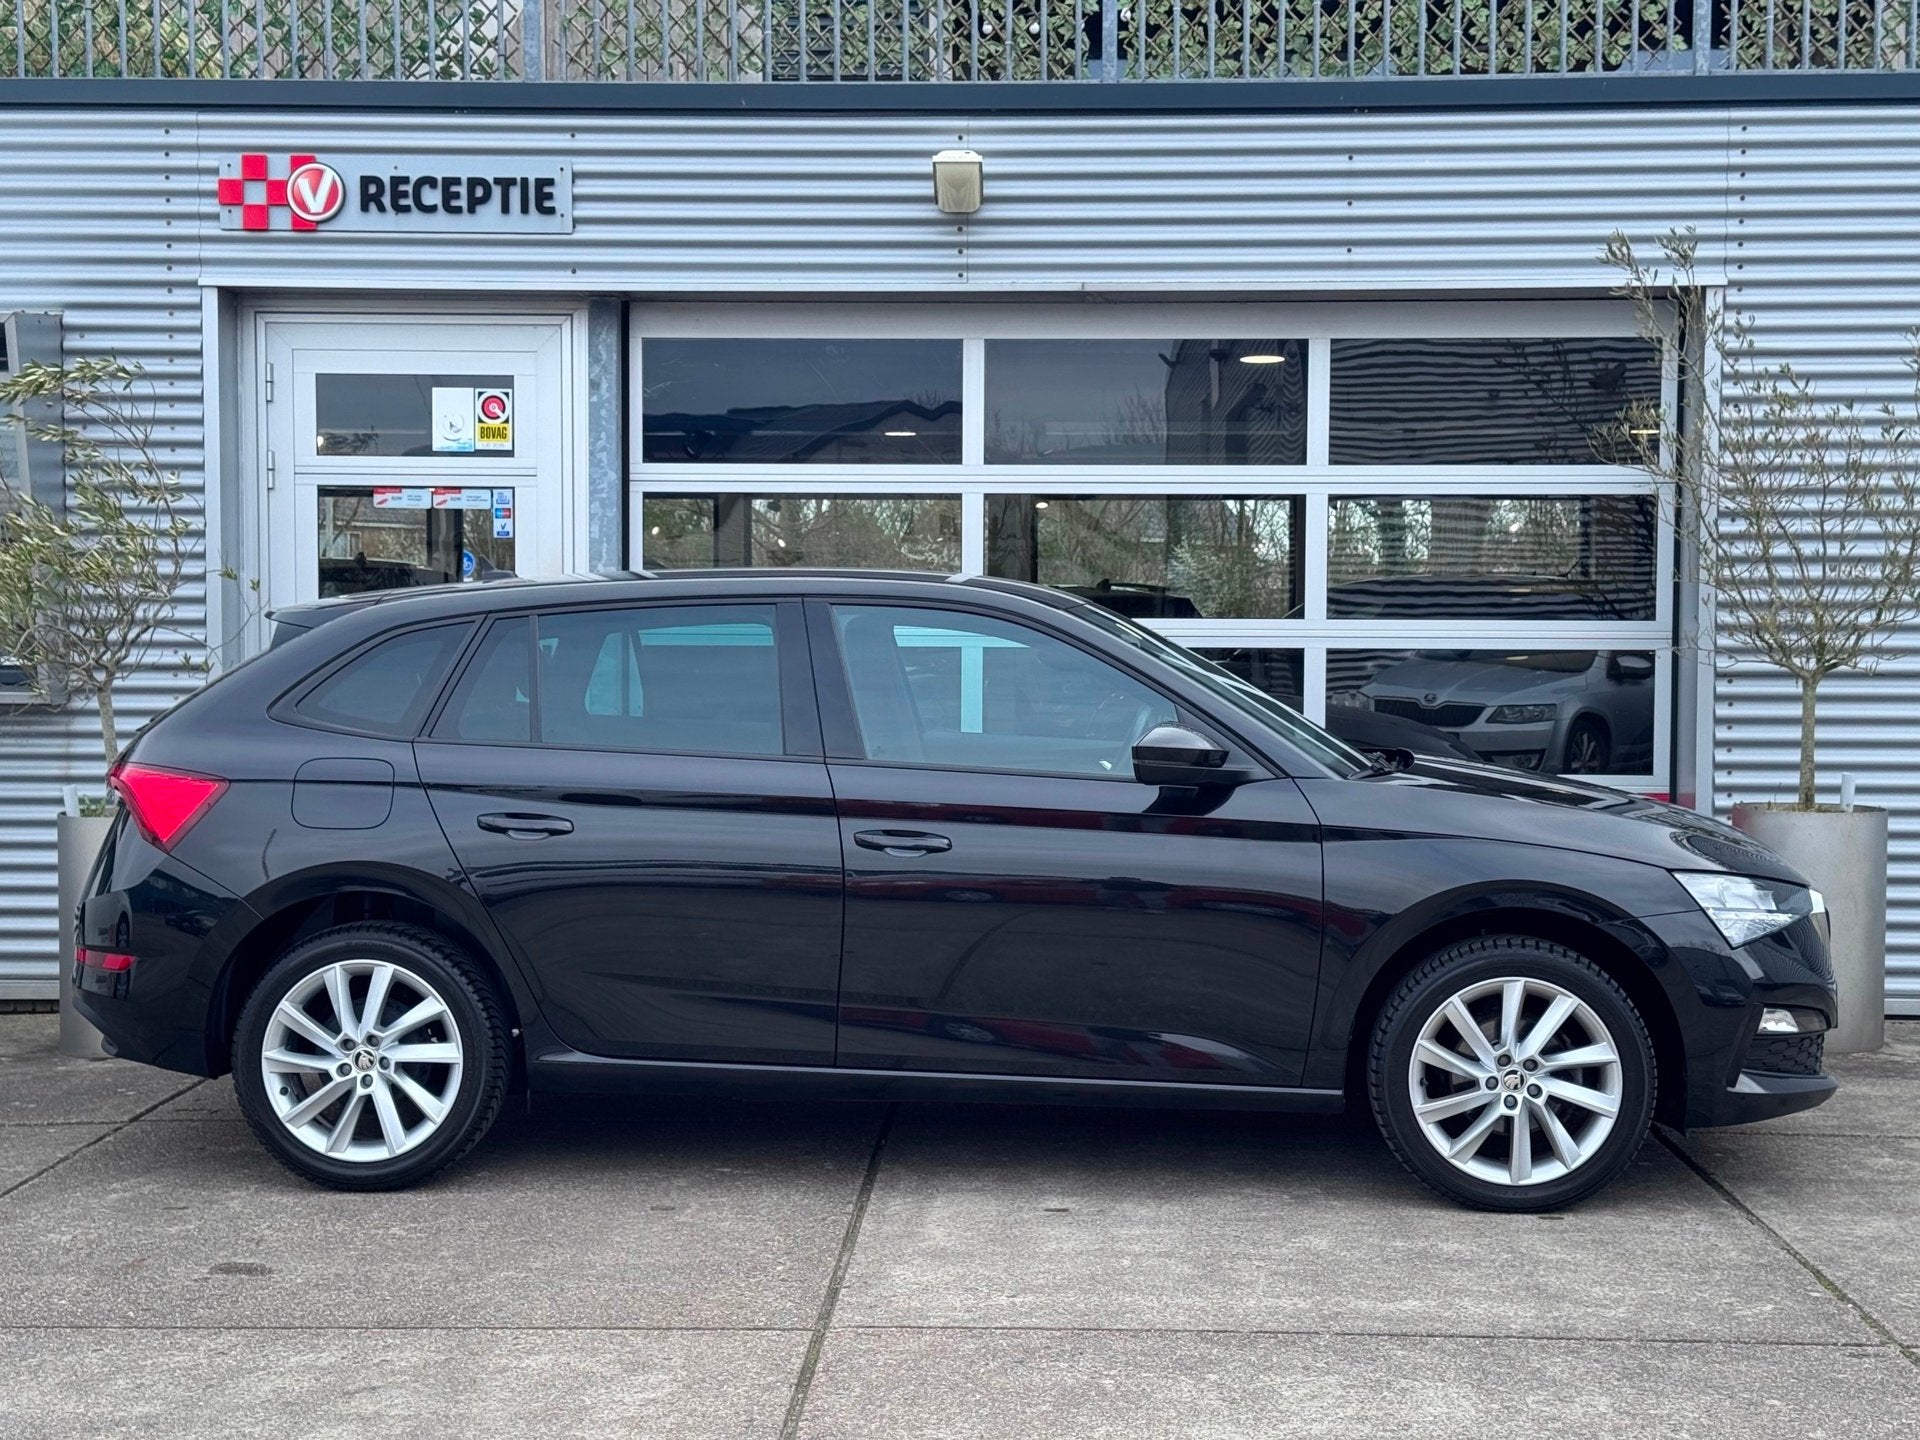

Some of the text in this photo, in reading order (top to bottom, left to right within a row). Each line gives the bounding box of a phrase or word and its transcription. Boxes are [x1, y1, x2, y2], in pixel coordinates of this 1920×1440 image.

[295, 167, 336, 214] V
[359, 174, 557, 216] RECEPTIE
[480, 425, 508, 440] BOVAG
